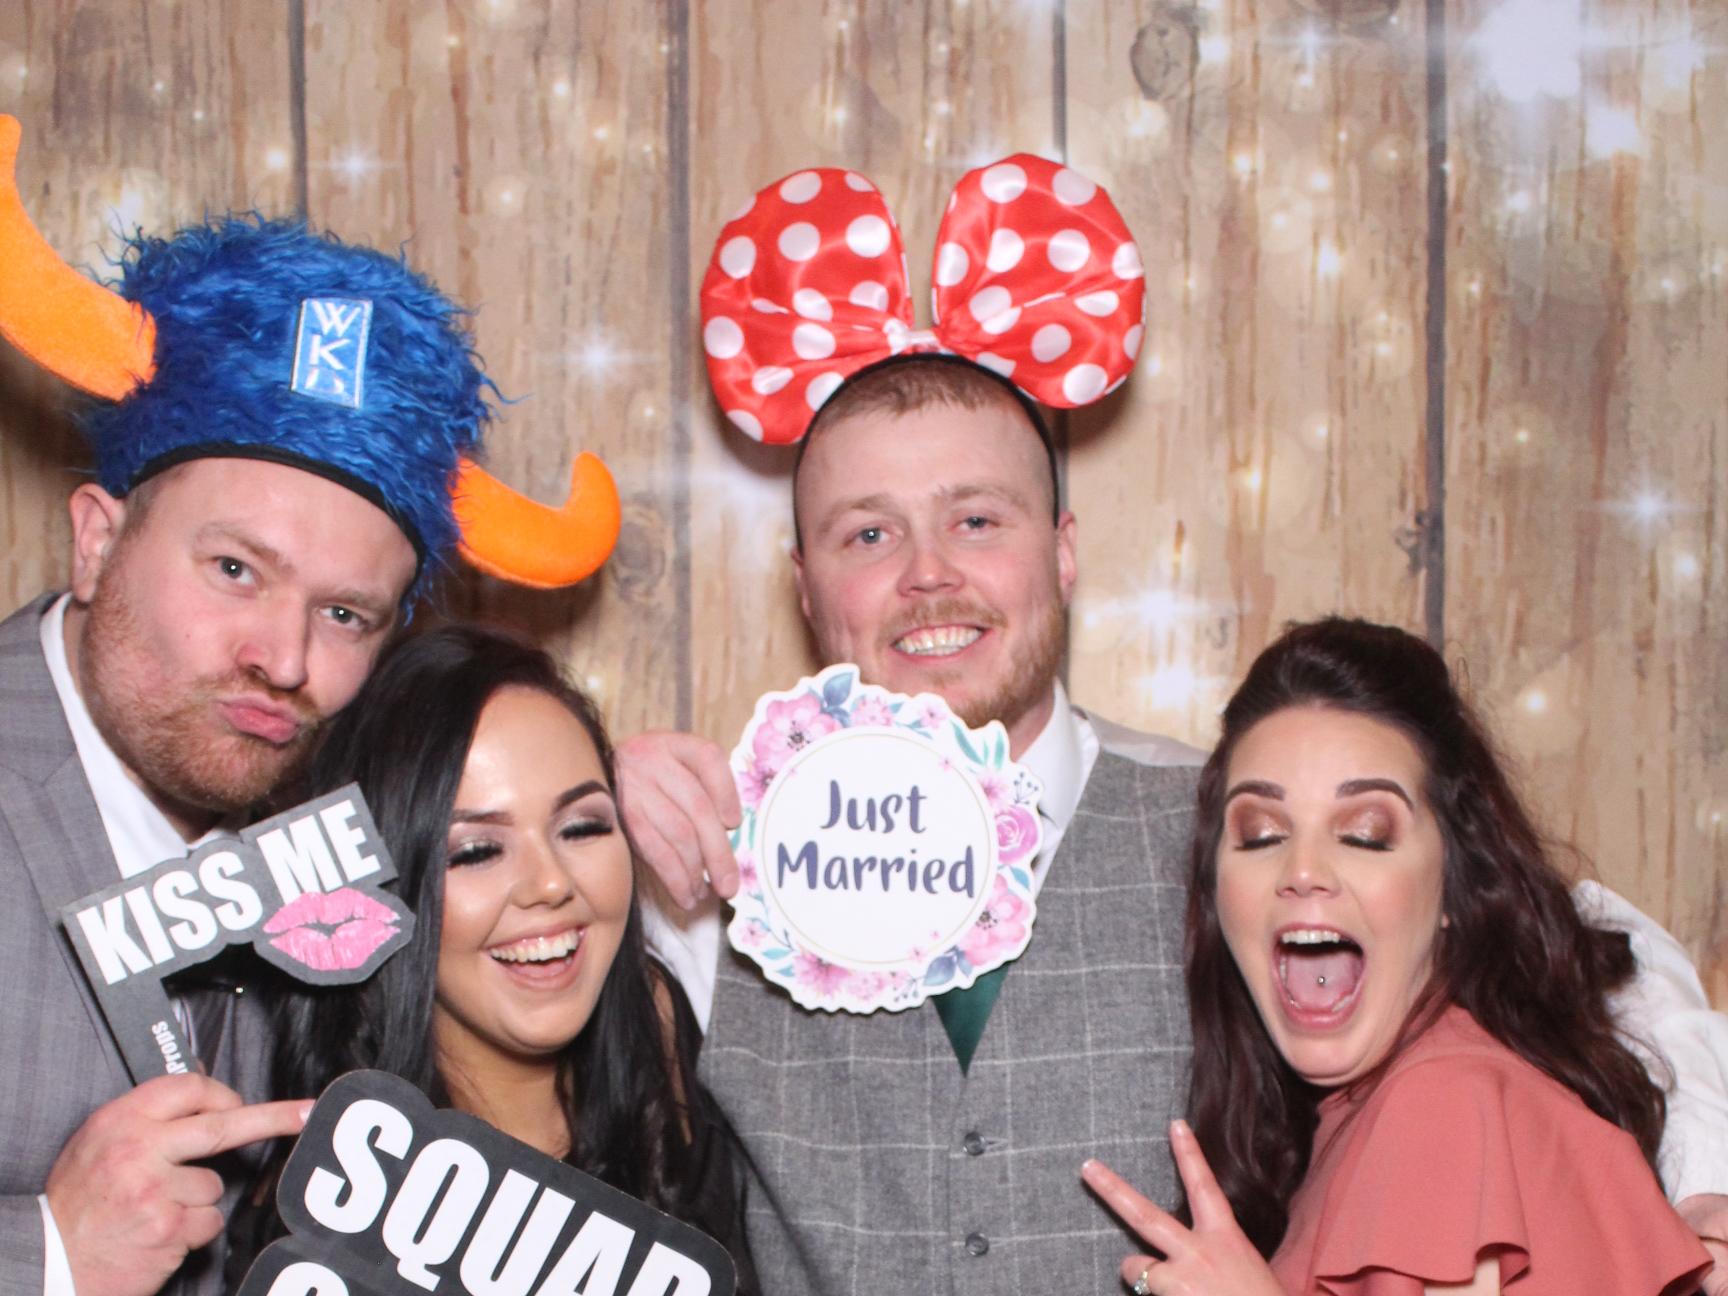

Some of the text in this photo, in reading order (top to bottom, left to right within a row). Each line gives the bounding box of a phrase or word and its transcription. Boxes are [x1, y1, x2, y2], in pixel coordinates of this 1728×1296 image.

[820, 779, 928, 834] Just
[76, 799, 382, 985] KISS ME
[777, 840, 975, 899] Married
[152, 1020, 188, 1074] Props
